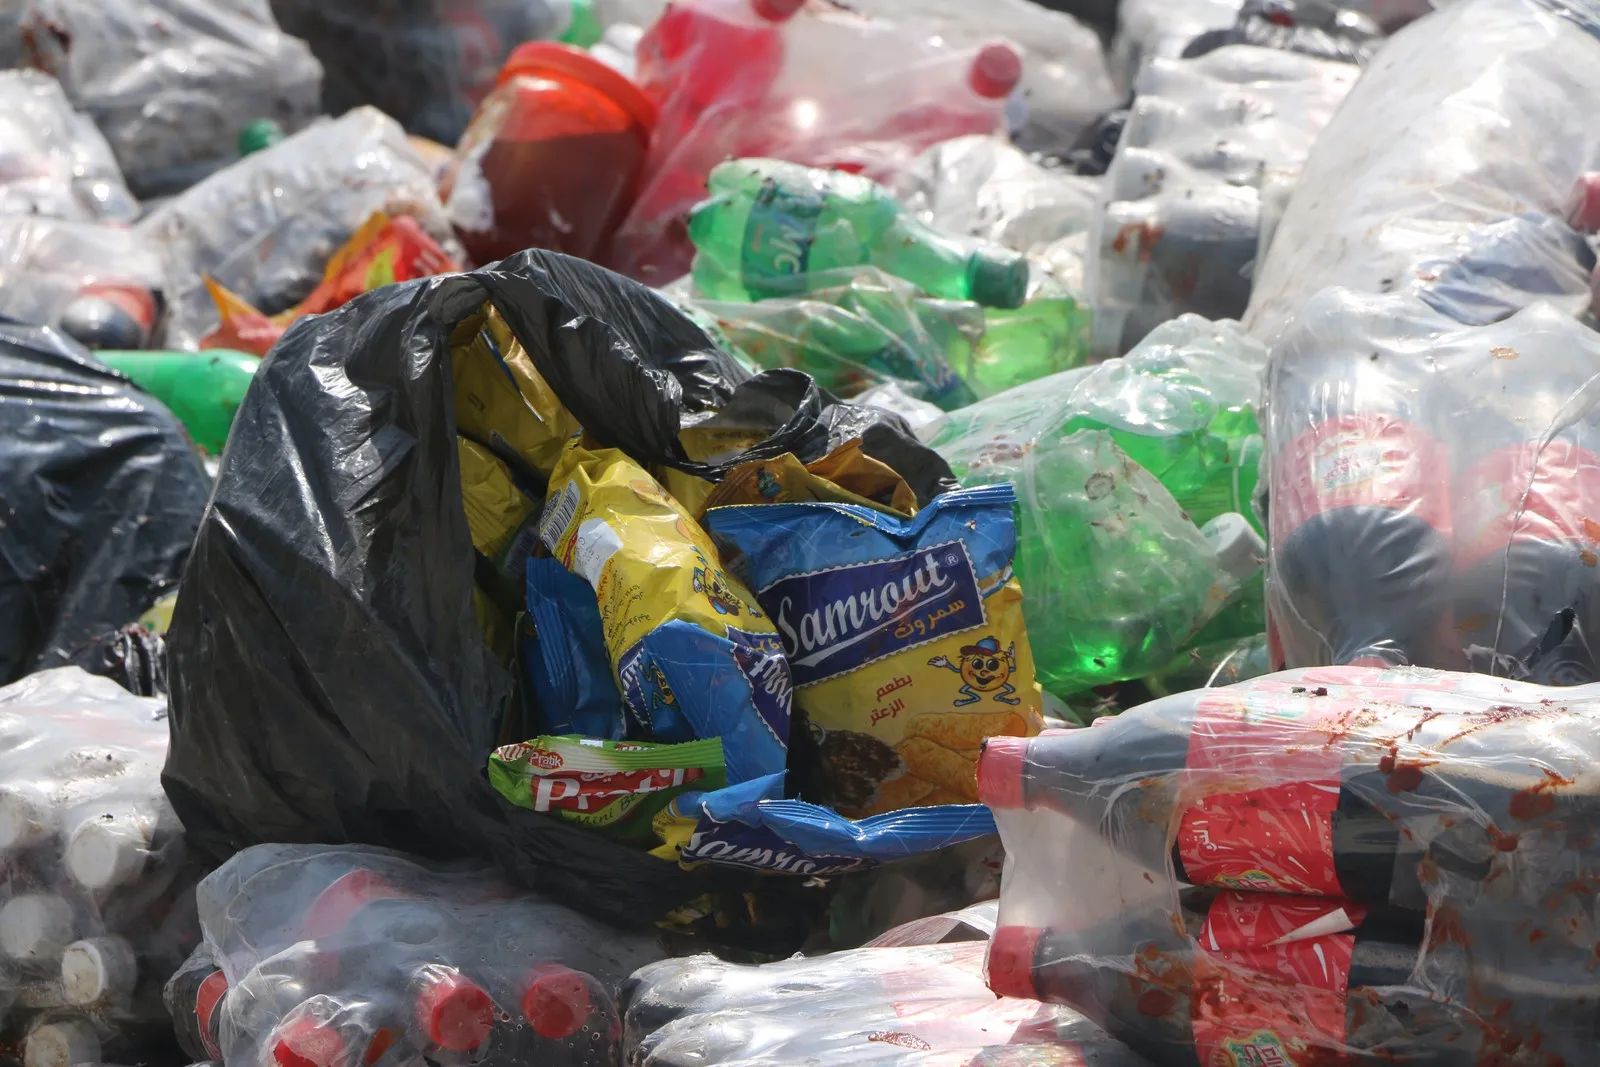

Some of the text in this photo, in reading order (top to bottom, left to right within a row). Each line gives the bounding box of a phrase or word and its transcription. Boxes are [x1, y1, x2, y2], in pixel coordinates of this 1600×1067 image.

[778, 553, 949, 660] Samrout
[893, 599, 967, 640] سمروت
[876, 674, 913, 703] بطعم
[870, 697, 905, 727] الزعتر
[530, 752, 562, 767] Pratik
